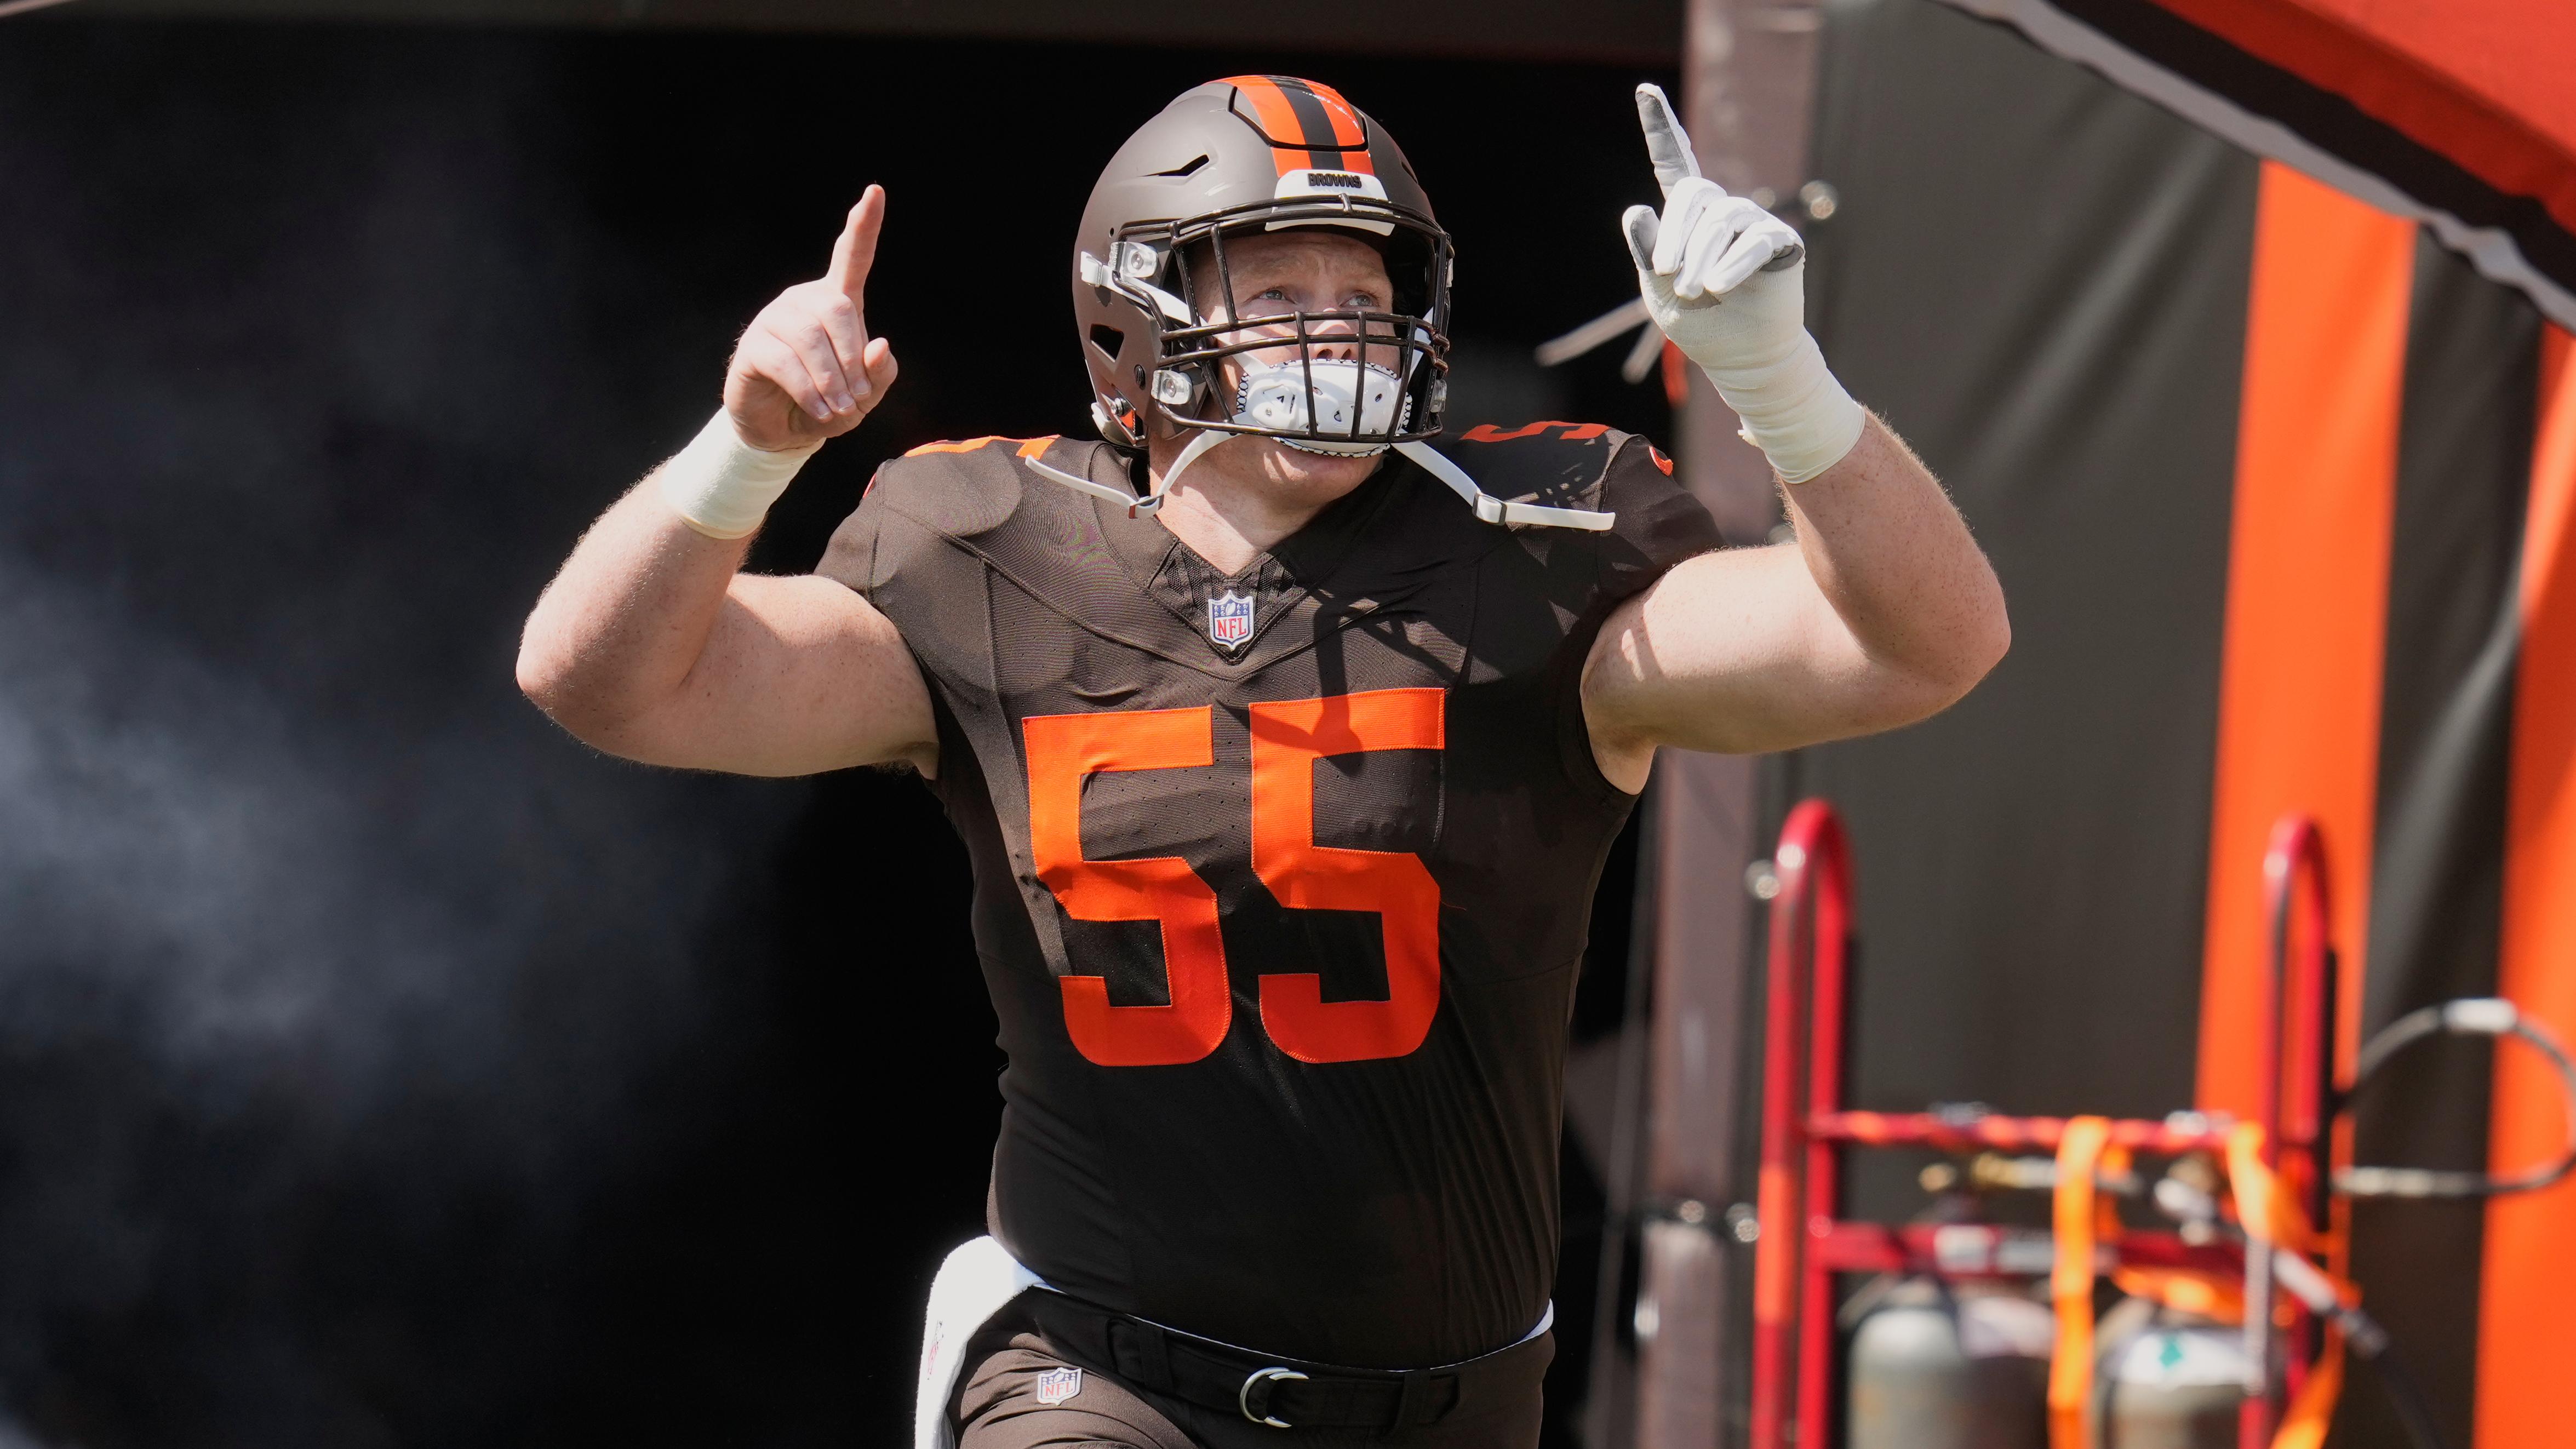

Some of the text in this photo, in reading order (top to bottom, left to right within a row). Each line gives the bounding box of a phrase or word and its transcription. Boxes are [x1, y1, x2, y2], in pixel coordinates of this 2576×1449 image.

[1308, 173, 1363, 188] BROWNS
[1216, 617, 1247, 639] NFL
[1021, 688, 1445, 1067] 55
[1045, 1382, 1073, 1396] NFL
